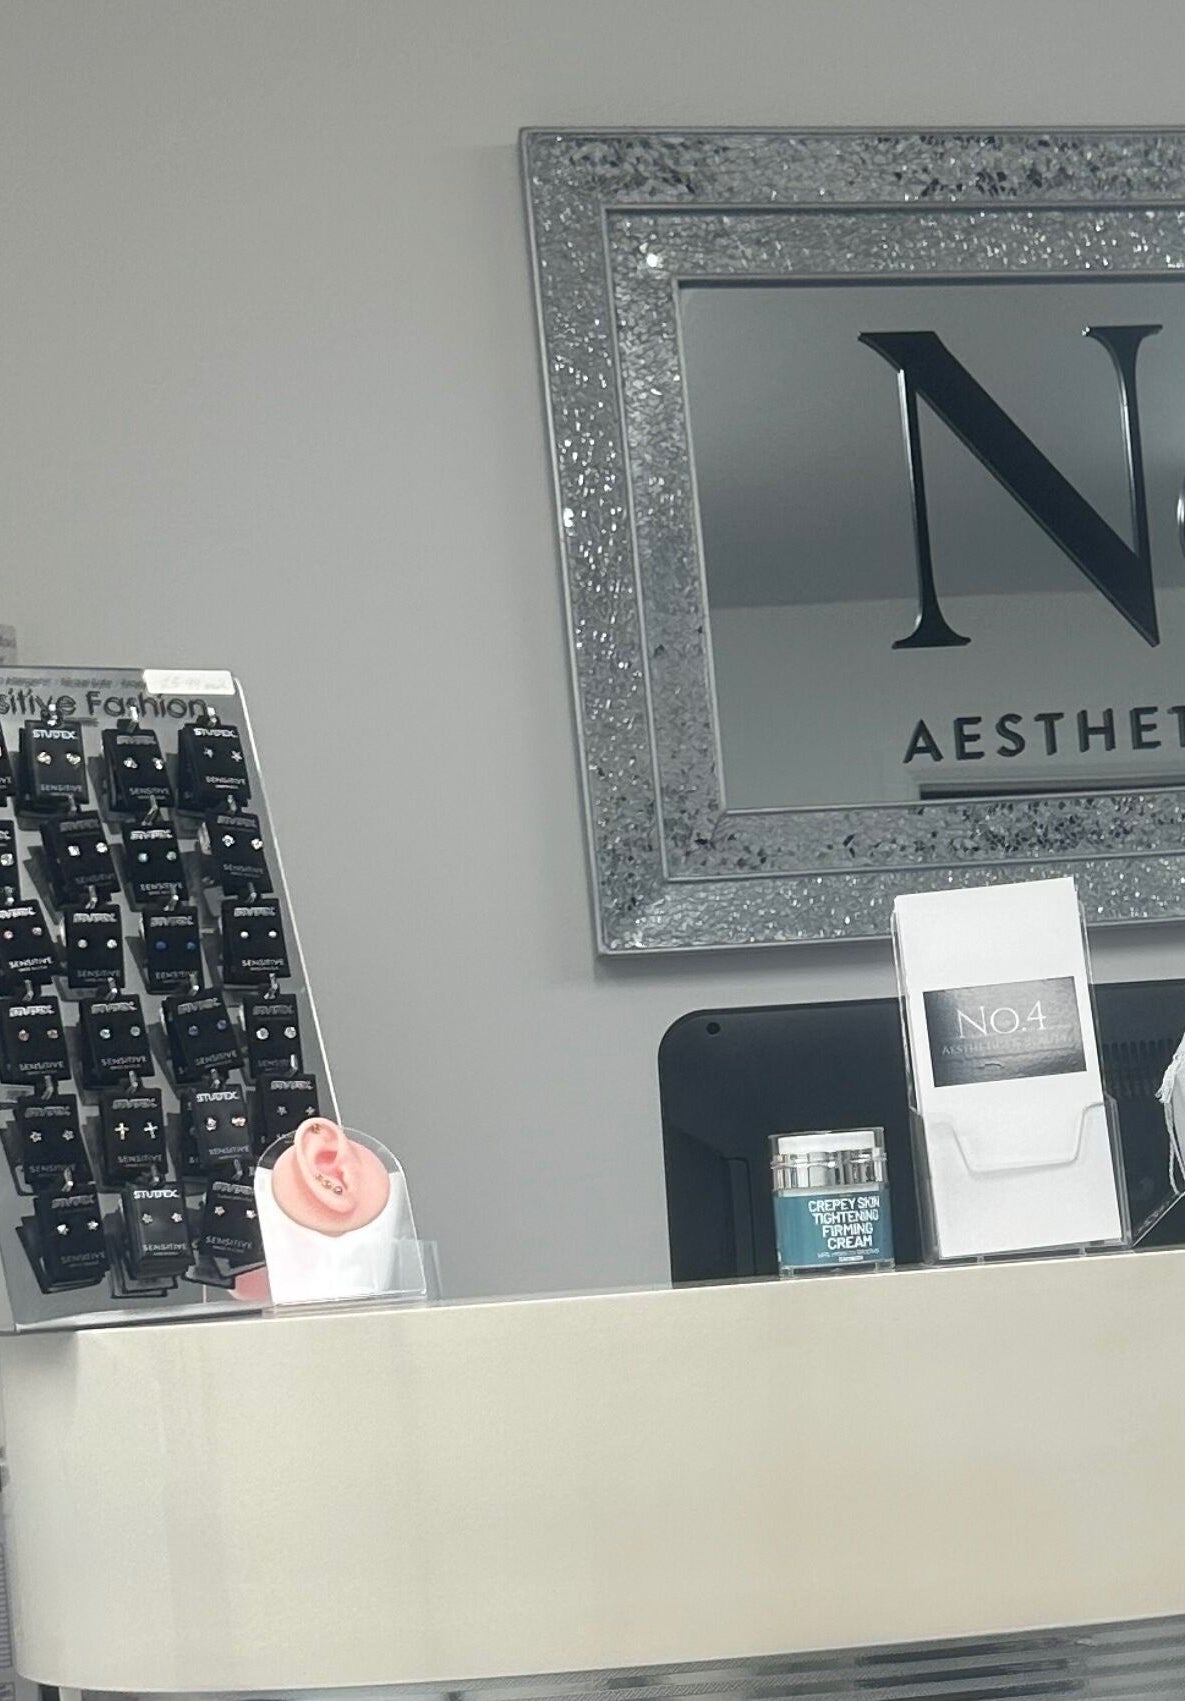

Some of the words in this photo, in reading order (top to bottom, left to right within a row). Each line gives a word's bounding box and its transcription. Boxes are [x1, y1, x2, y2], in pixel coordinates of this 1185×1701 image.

[956, 1000, 1047, 1039] NO.4
[808, 1196, 857, 1213] CREPEY
[857, 1195, 881, 1210] SKIN
[812, 1209, 879, 1225] TIGHTENING
[822, 1222, 874, 1238] FIRMING
[827, 1236, 873, 1250] CREAM
